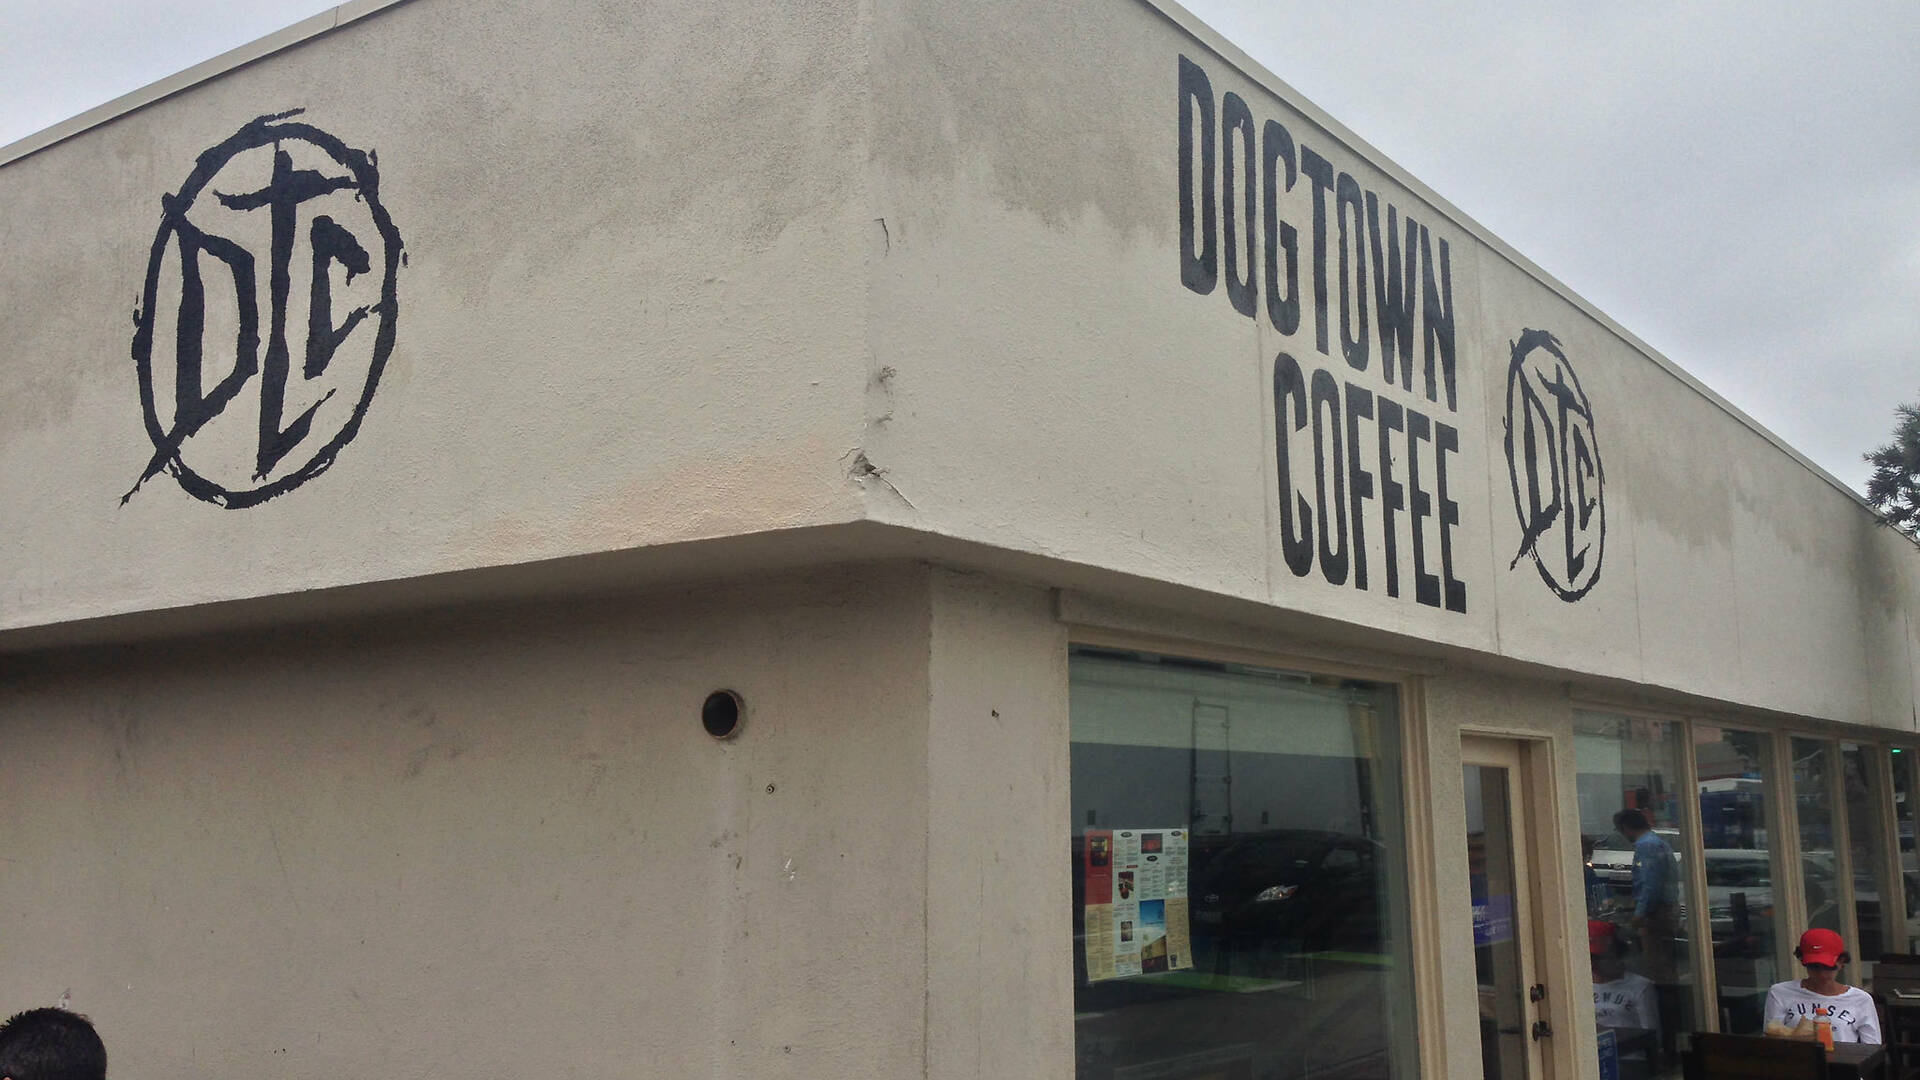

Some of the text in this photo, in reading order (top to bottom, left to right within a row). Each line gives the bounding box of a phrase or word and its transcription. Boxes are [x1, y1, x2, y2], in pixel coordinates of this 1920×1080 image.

[173, 144, 371, 483] DTC
[1178, 53, 1457, 413] DOGTOWN
[1273, 352, 1467, 614] COFFEE
[1516, 361, 1597, 586] DTC
